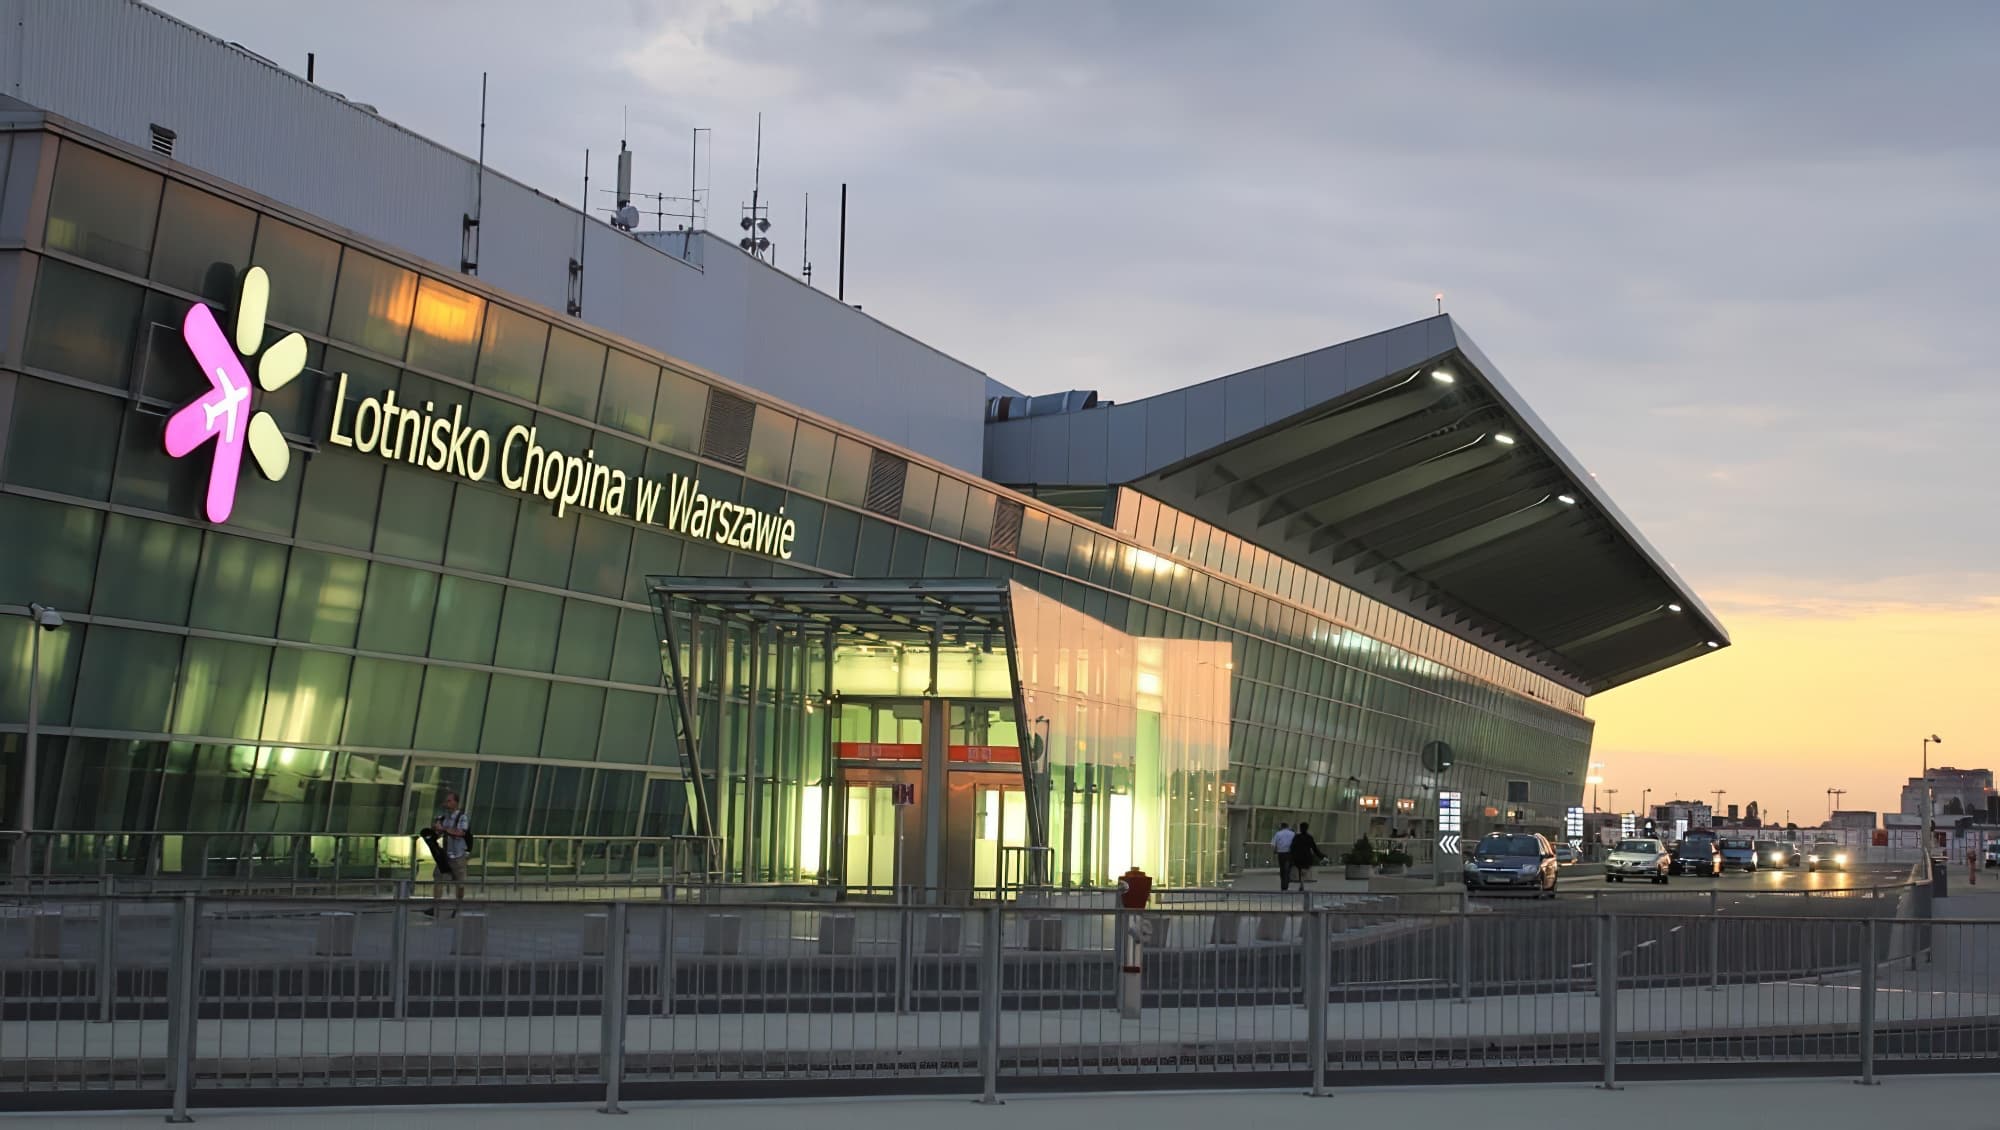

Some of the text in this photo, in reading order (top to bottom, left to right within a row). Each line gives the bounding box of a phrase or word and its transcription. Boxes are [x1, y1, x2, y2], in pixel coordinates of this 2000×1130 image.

[330, 372, 795, 560] Lotnisko Chopina w Warszawie
